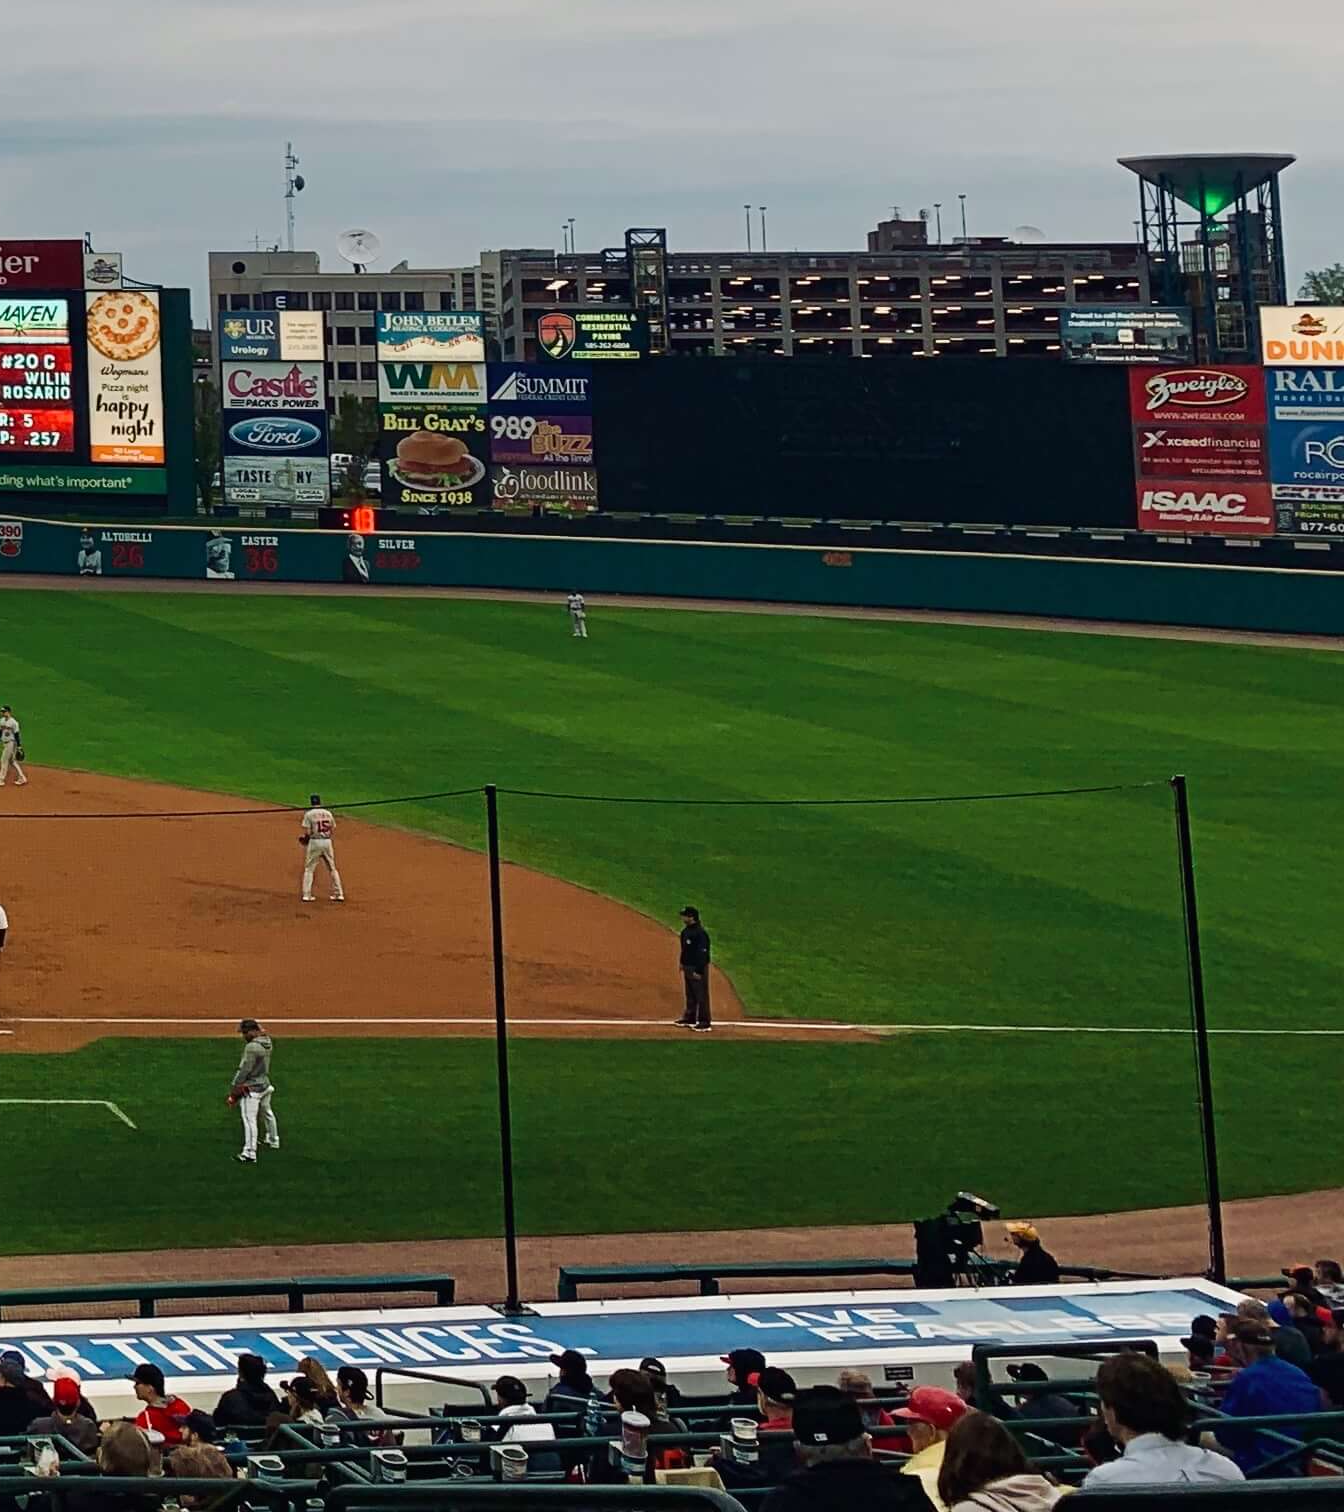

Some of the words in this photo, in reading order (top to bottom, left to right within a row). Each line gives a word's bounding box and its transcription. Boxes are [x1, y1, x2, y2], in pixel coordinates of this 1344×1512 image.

[380, 313, 423, 332] JOHN
[427, 315, 480, 326] BETLEM
[575, 314, 628, 322] COMMERCIAL
[246, 319, 275, 335] UR
[231, 346, 269, 356] Urology
[1, 353, 39, 369] #20
[43, 354, 56, 369] C
[24, 372, 71, 386] WILIN
[100, 363, 149, 381] Wegmans
[382, 364, 479, 390] WM
[101, 384, 124, 392] Pizza
[126, 384, 149, 393] night
[227, 364, 317, 399] Castle
[516, 378, 589, 394] SUMMIT
[2, 385, 71, 400] ROSARIO
[1146, 375, 1247, 410] Zweigle's
[96, 394, 149, 420] happy
[246, 399, 279, 408] PACKS
[282, 399, 319, 408] POWER
[23, 414, 34, 427] 5
[23, 431, 61, 446] .257
[111, 419, 154, 443] night
[247, 421, 302, 443] Ford
[531, 434, 593, 455] BUZZ
[1166, 437, 1260, 448] xceedfinancial
[26, 474, 64, 487] what's
[236, 469, 272, 483] TASTE
[296, 470, 313, 484] NY
[519, 469, 595, 491] foodlink
[400, 489, 438, 503] SINCE
[440, 491, 473, 505] 1938
[1141, 491, 1247, 514] ISAAC
[1214, 514, 1271, 525] Conditioning
[101, 531, 153, 543] ALTOBELLI
[241, 536, 279, 547] EASTER
[378, 539, 416, 550] SILVER
[112, 545, 145, 569] 26
[245, 549, 279, 573] 36
[733, 1307, 912, 1329] LIVE
[90, 1332, 276, 1373] THE
